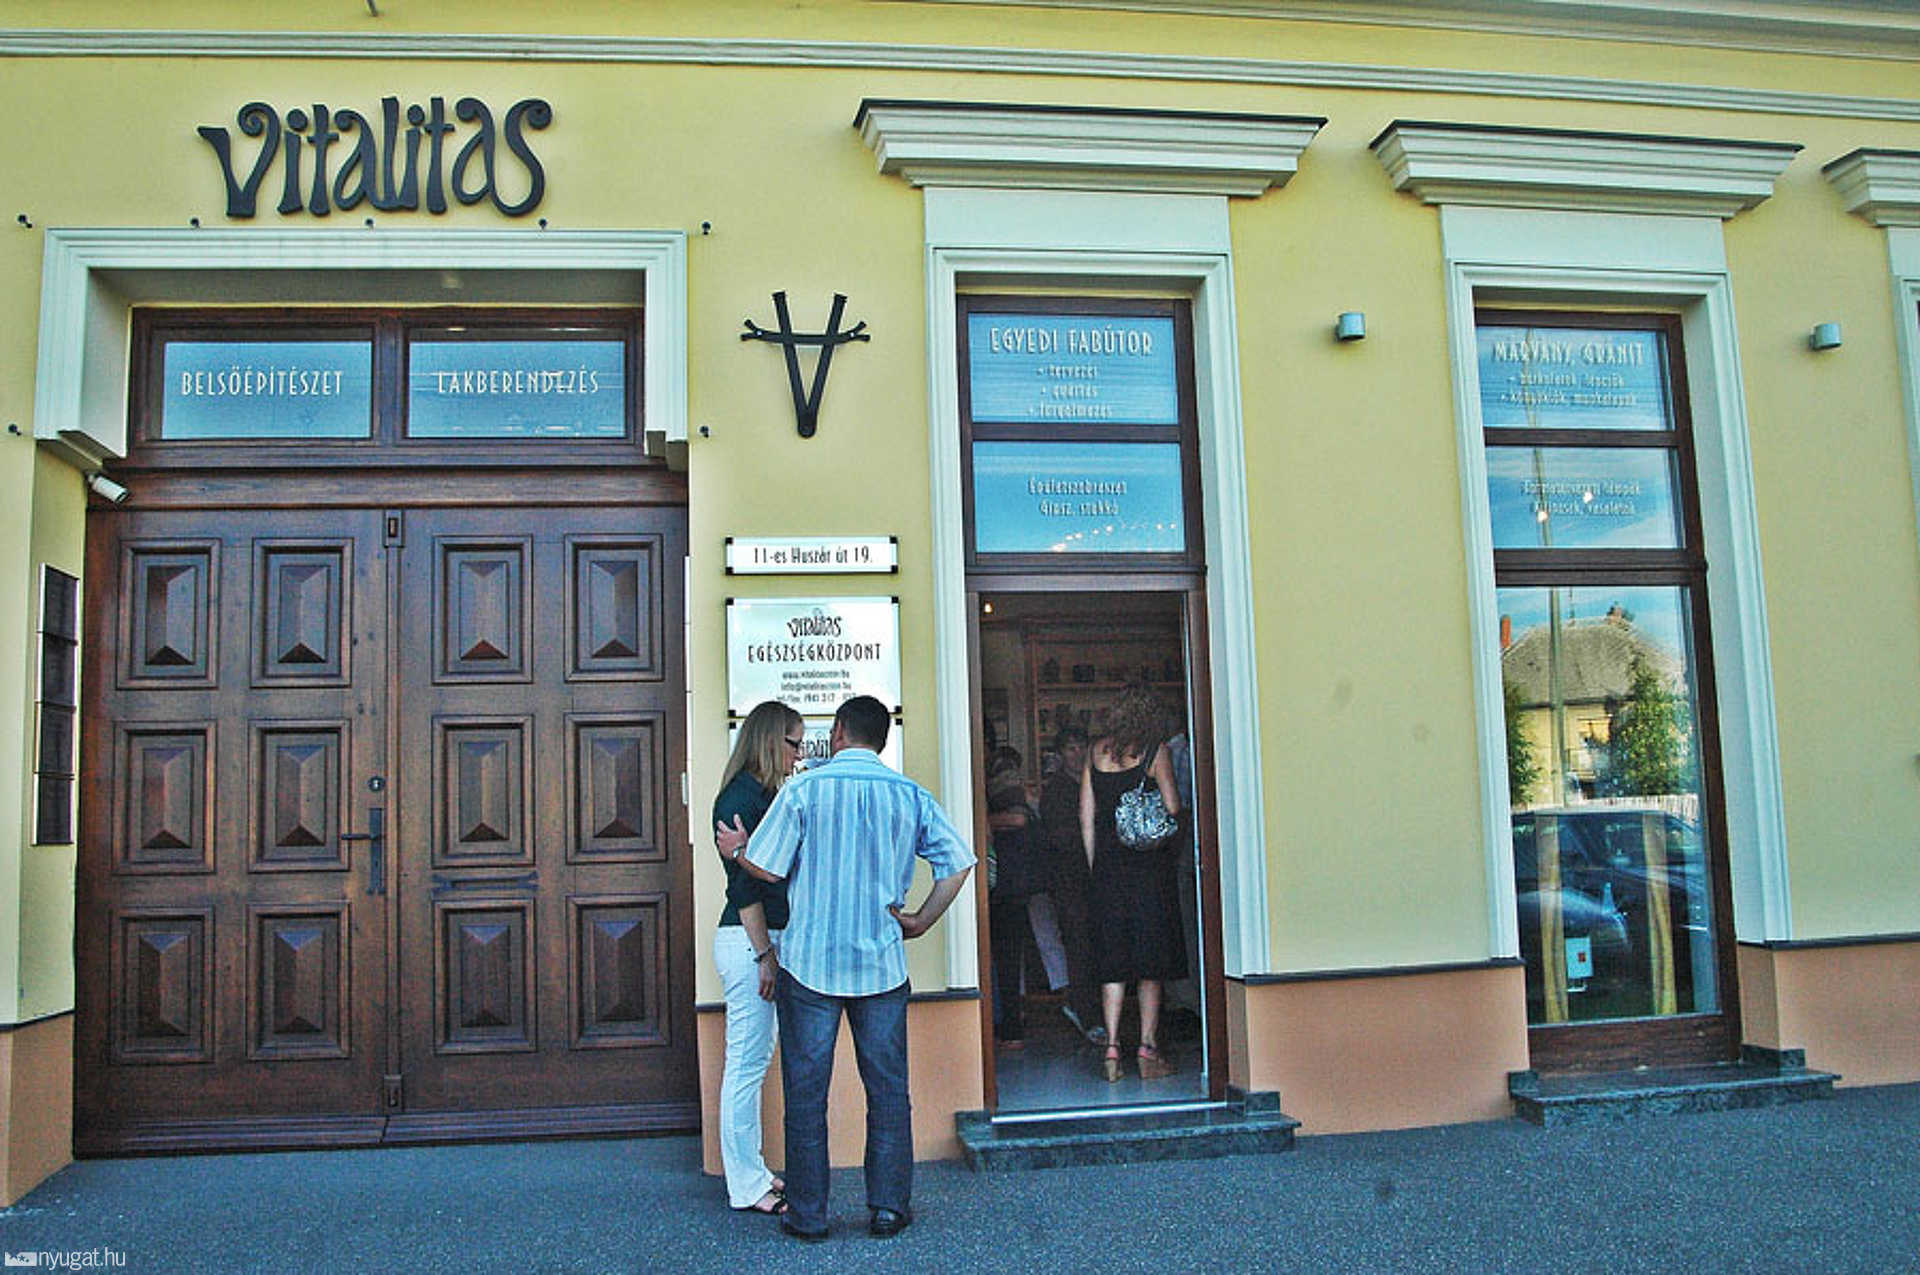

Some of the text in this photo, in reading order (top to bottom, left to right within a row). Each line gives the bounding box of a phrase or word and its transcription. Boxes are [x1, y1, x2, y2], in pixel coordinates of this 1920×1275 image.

[990, 324, 1153, 356] EGYEDI FABÚTOR
[182, 365, 600, 397] BELSŐÉPÍTÉSZET LAKBERENDEZÉS
[754, 545, 873, 563] 11-es Huszár út 19.
[748, 640, 881, 663] EGÉSZSÉGKÖZPONT
